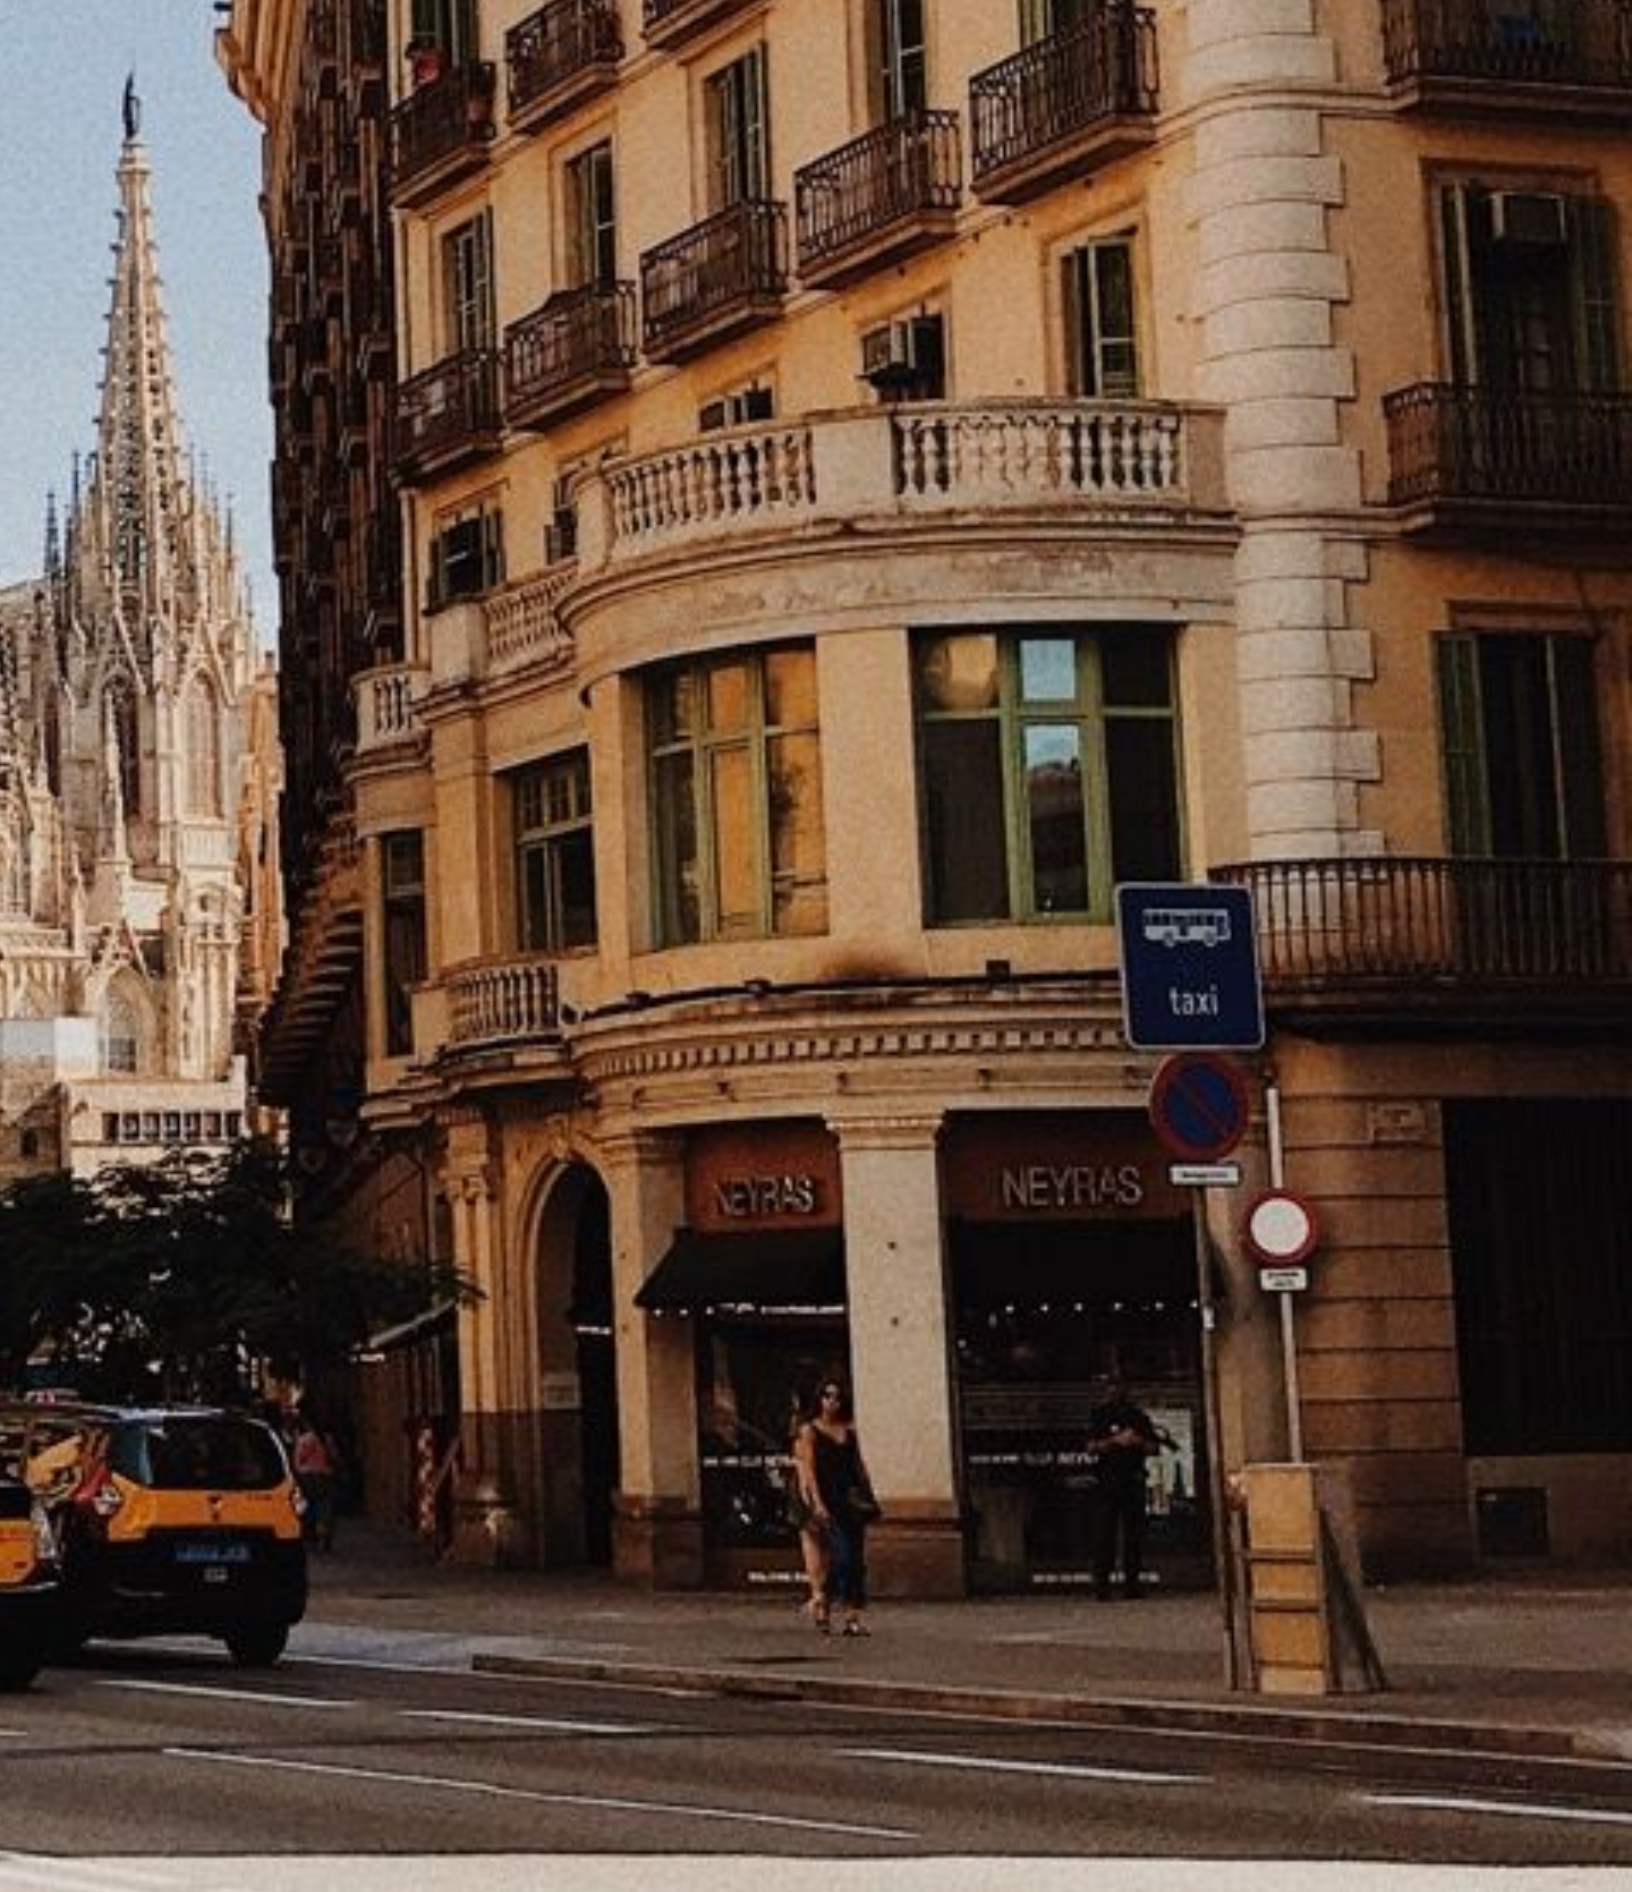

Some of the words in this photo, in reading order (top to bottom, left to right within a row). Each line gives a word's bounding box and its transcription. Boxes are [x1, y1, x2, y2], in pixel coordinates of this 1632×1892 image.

[1169, 983, 1218, 1016] taxi
[715, 1175, 815, 1216] NEYRAS
[1002, 1166, 1143, 1207] NEYRAS
